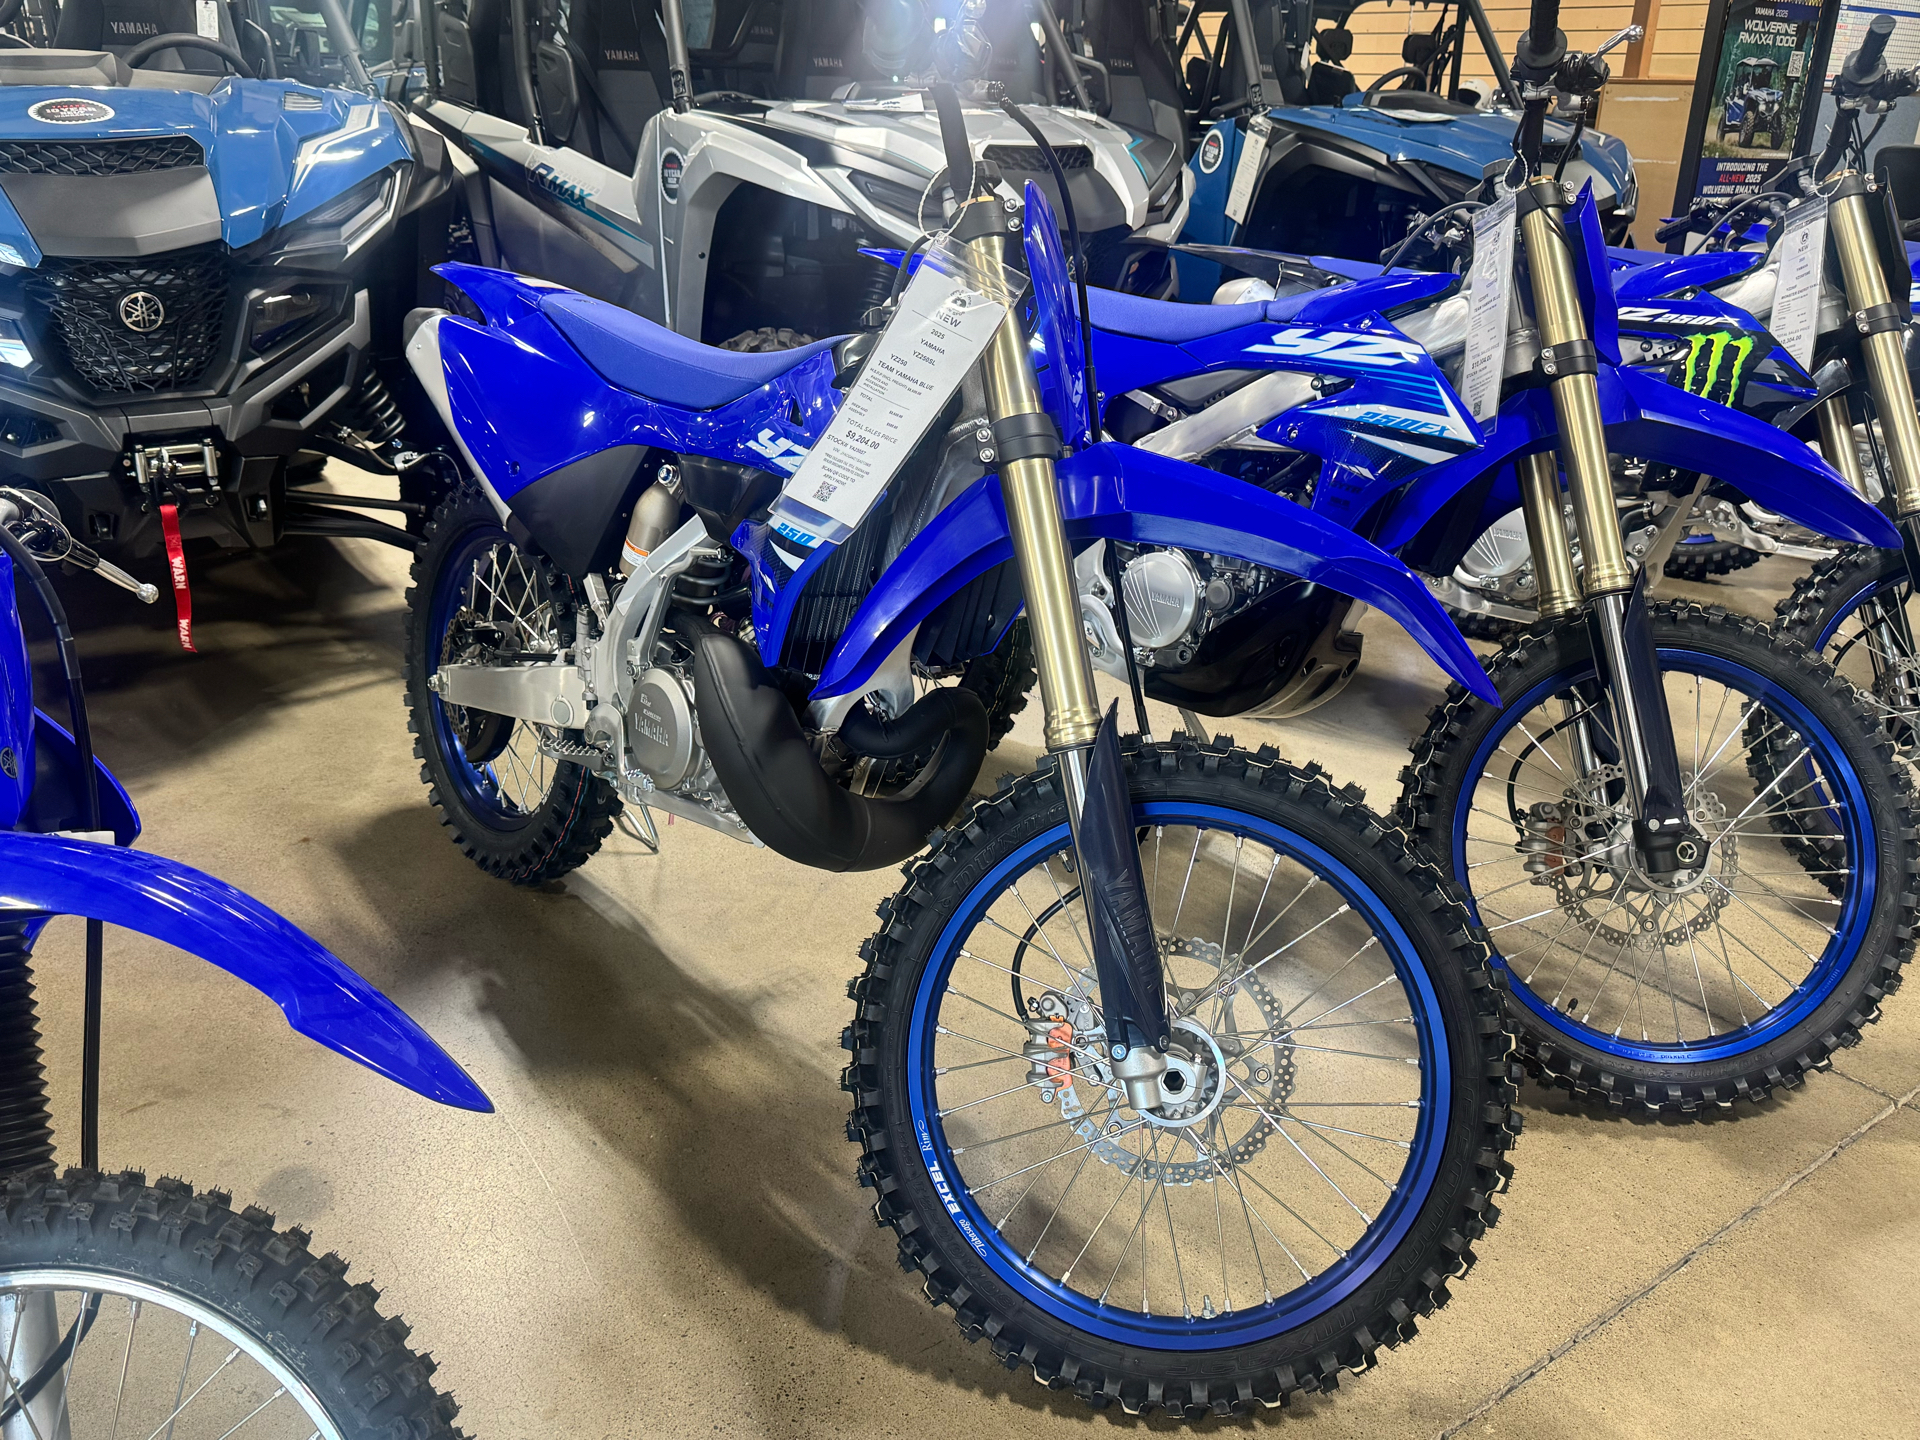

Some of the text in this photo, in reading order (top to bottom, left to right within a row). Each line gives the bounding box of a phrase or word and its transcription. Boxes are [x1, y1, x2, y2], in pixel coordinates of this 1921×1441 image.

[1755, 7, 1789, 17] YAMAHA 2025
[111, 22, 158, 35] YAMAHA
[1744, 19, 1798, 34] WOLVERINE
[1739, 32, 1797, 47] RMAX4 1000
[604, 50, 640, 61] YAMAHA
[813, 57, 843, 68] YAMAHA
[1716, 162, 1769, 172] INTRODUCING THE
[1719, 174, 1762, 183] ALL-NEW 2025
[1702, 185, 1735, 194] WOLVERINE
[935, 310, 961, 328] NEW
[931, 329, 945, 339] 2025
[920, 338, 945, 354] YAMAHA
[1240, 328, 1427, 366] YZ
[890, 354, 907, 366] YZ250
[878, 360, 934, 392] TEAM YAMAHA BLUE
[860, 392, 873, 401] TOTAL
[846, 417, 898, 445] TOTAL SALES PRICE
[1355, 411, 1456, 436] 250FX
[827, 434, 848, 447] STOCK#
[845, 429, 880, 451] $9,204.00
[776, 522, 816, 548] 250
[171, 556, 186, 589] WARN
[1151, 591, 1180, 608] YAMAHA
[179, 619, 192, 649] WARN
[634, 712, 669, 746] YAMAHA
[950, 800, 1069, 895] DUNLO
[1104, 868, 1160, 993] YAMAHA
[917, 1120, 932, 1151] Rim
[929, 1160, 962, 1215] EXCEL
